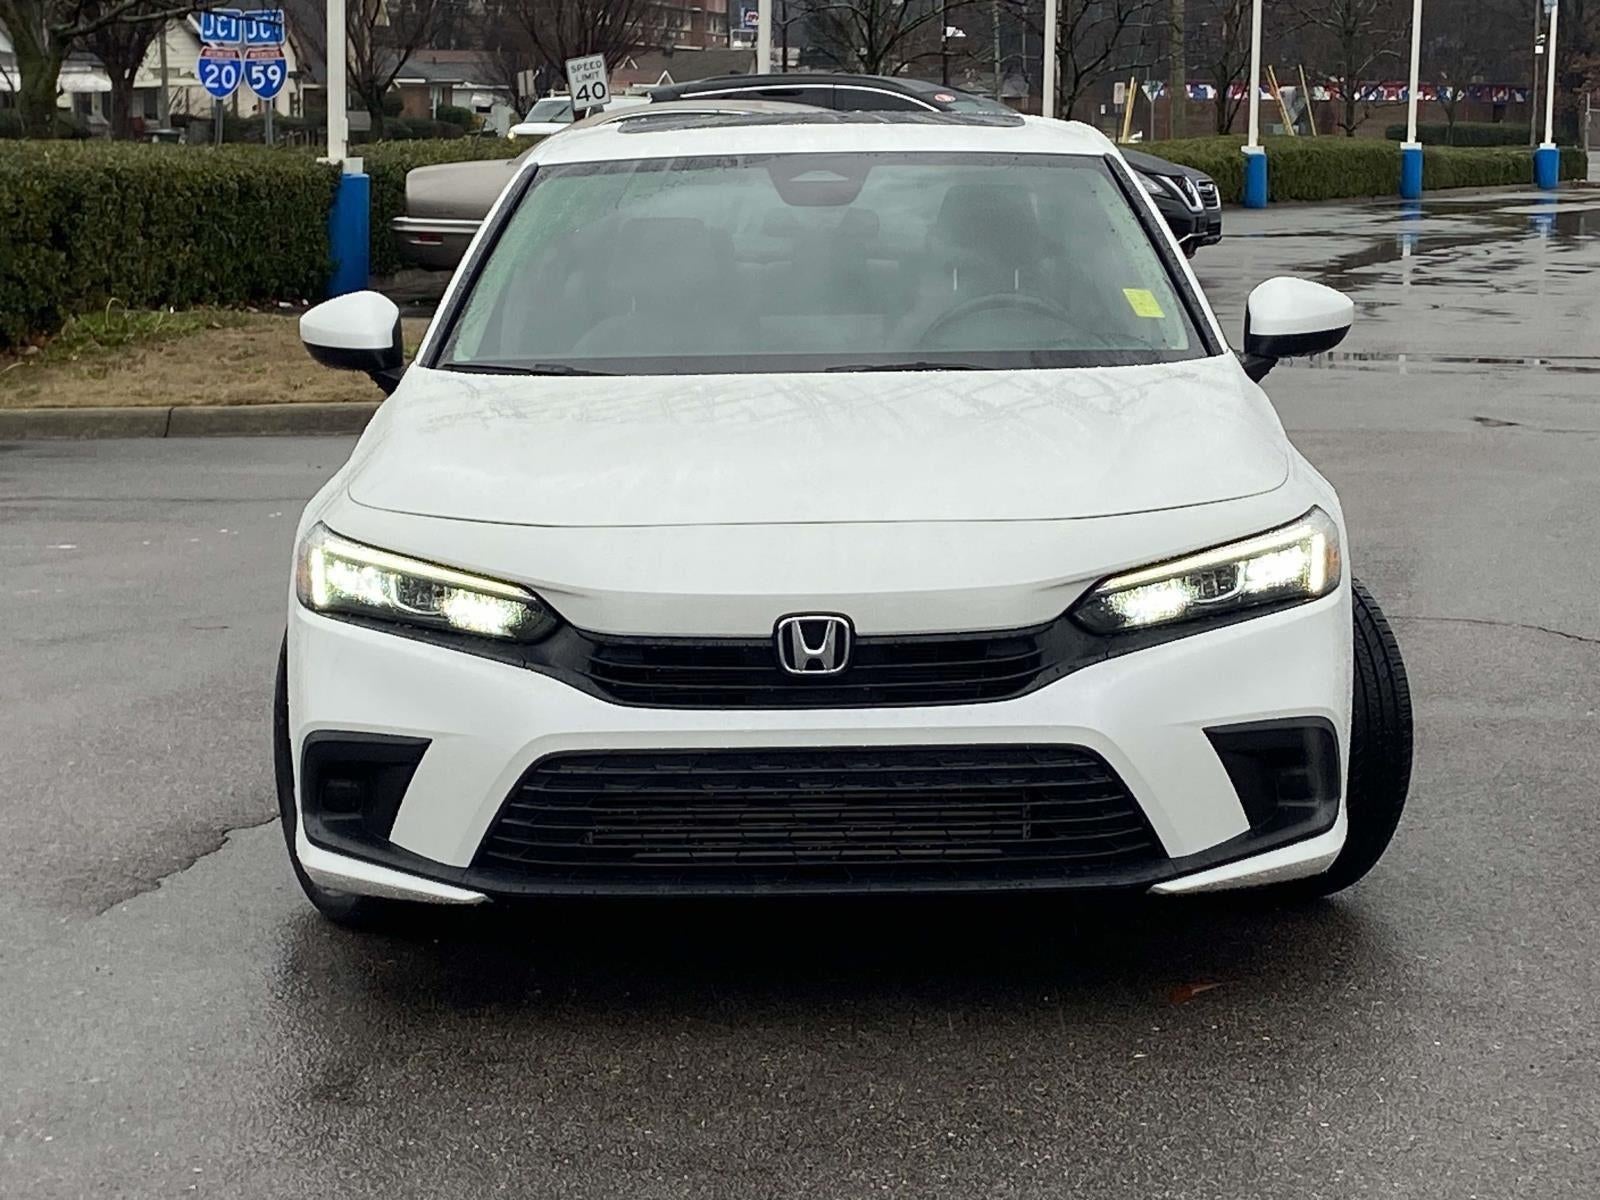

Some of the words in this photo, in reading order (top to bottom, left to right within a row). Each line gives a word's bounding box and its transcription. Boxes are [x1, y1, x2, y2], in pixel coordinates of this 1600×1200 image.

[205, 64, 236, 89] 20
[571, 60, 602, 73] SPEED
[251, 64, 281, 90] 59
[576, 71, 599, 83] LIMIT
[576, 81, 606, 101] 40
